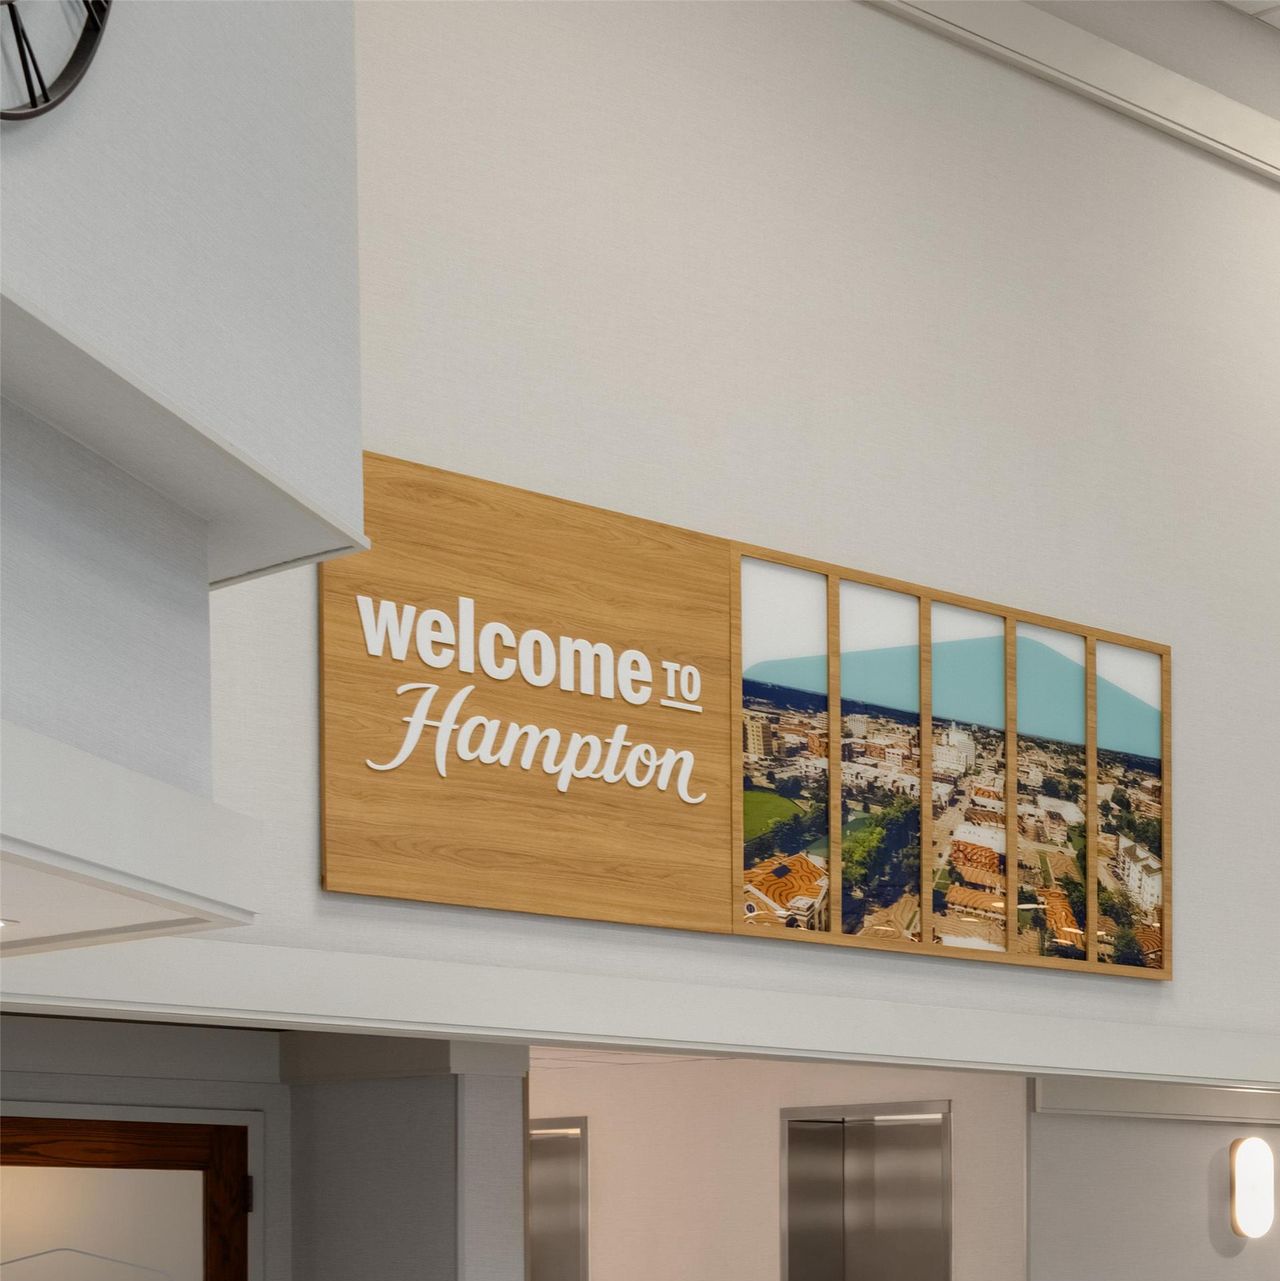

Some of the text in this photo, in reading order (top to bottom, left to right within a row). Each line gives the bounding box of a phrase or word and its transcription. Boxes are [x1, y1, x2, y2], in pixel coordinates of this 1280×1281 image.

[356, 594, 703, 713] welcome TO
[365, 682, 707, 804] Hampton
